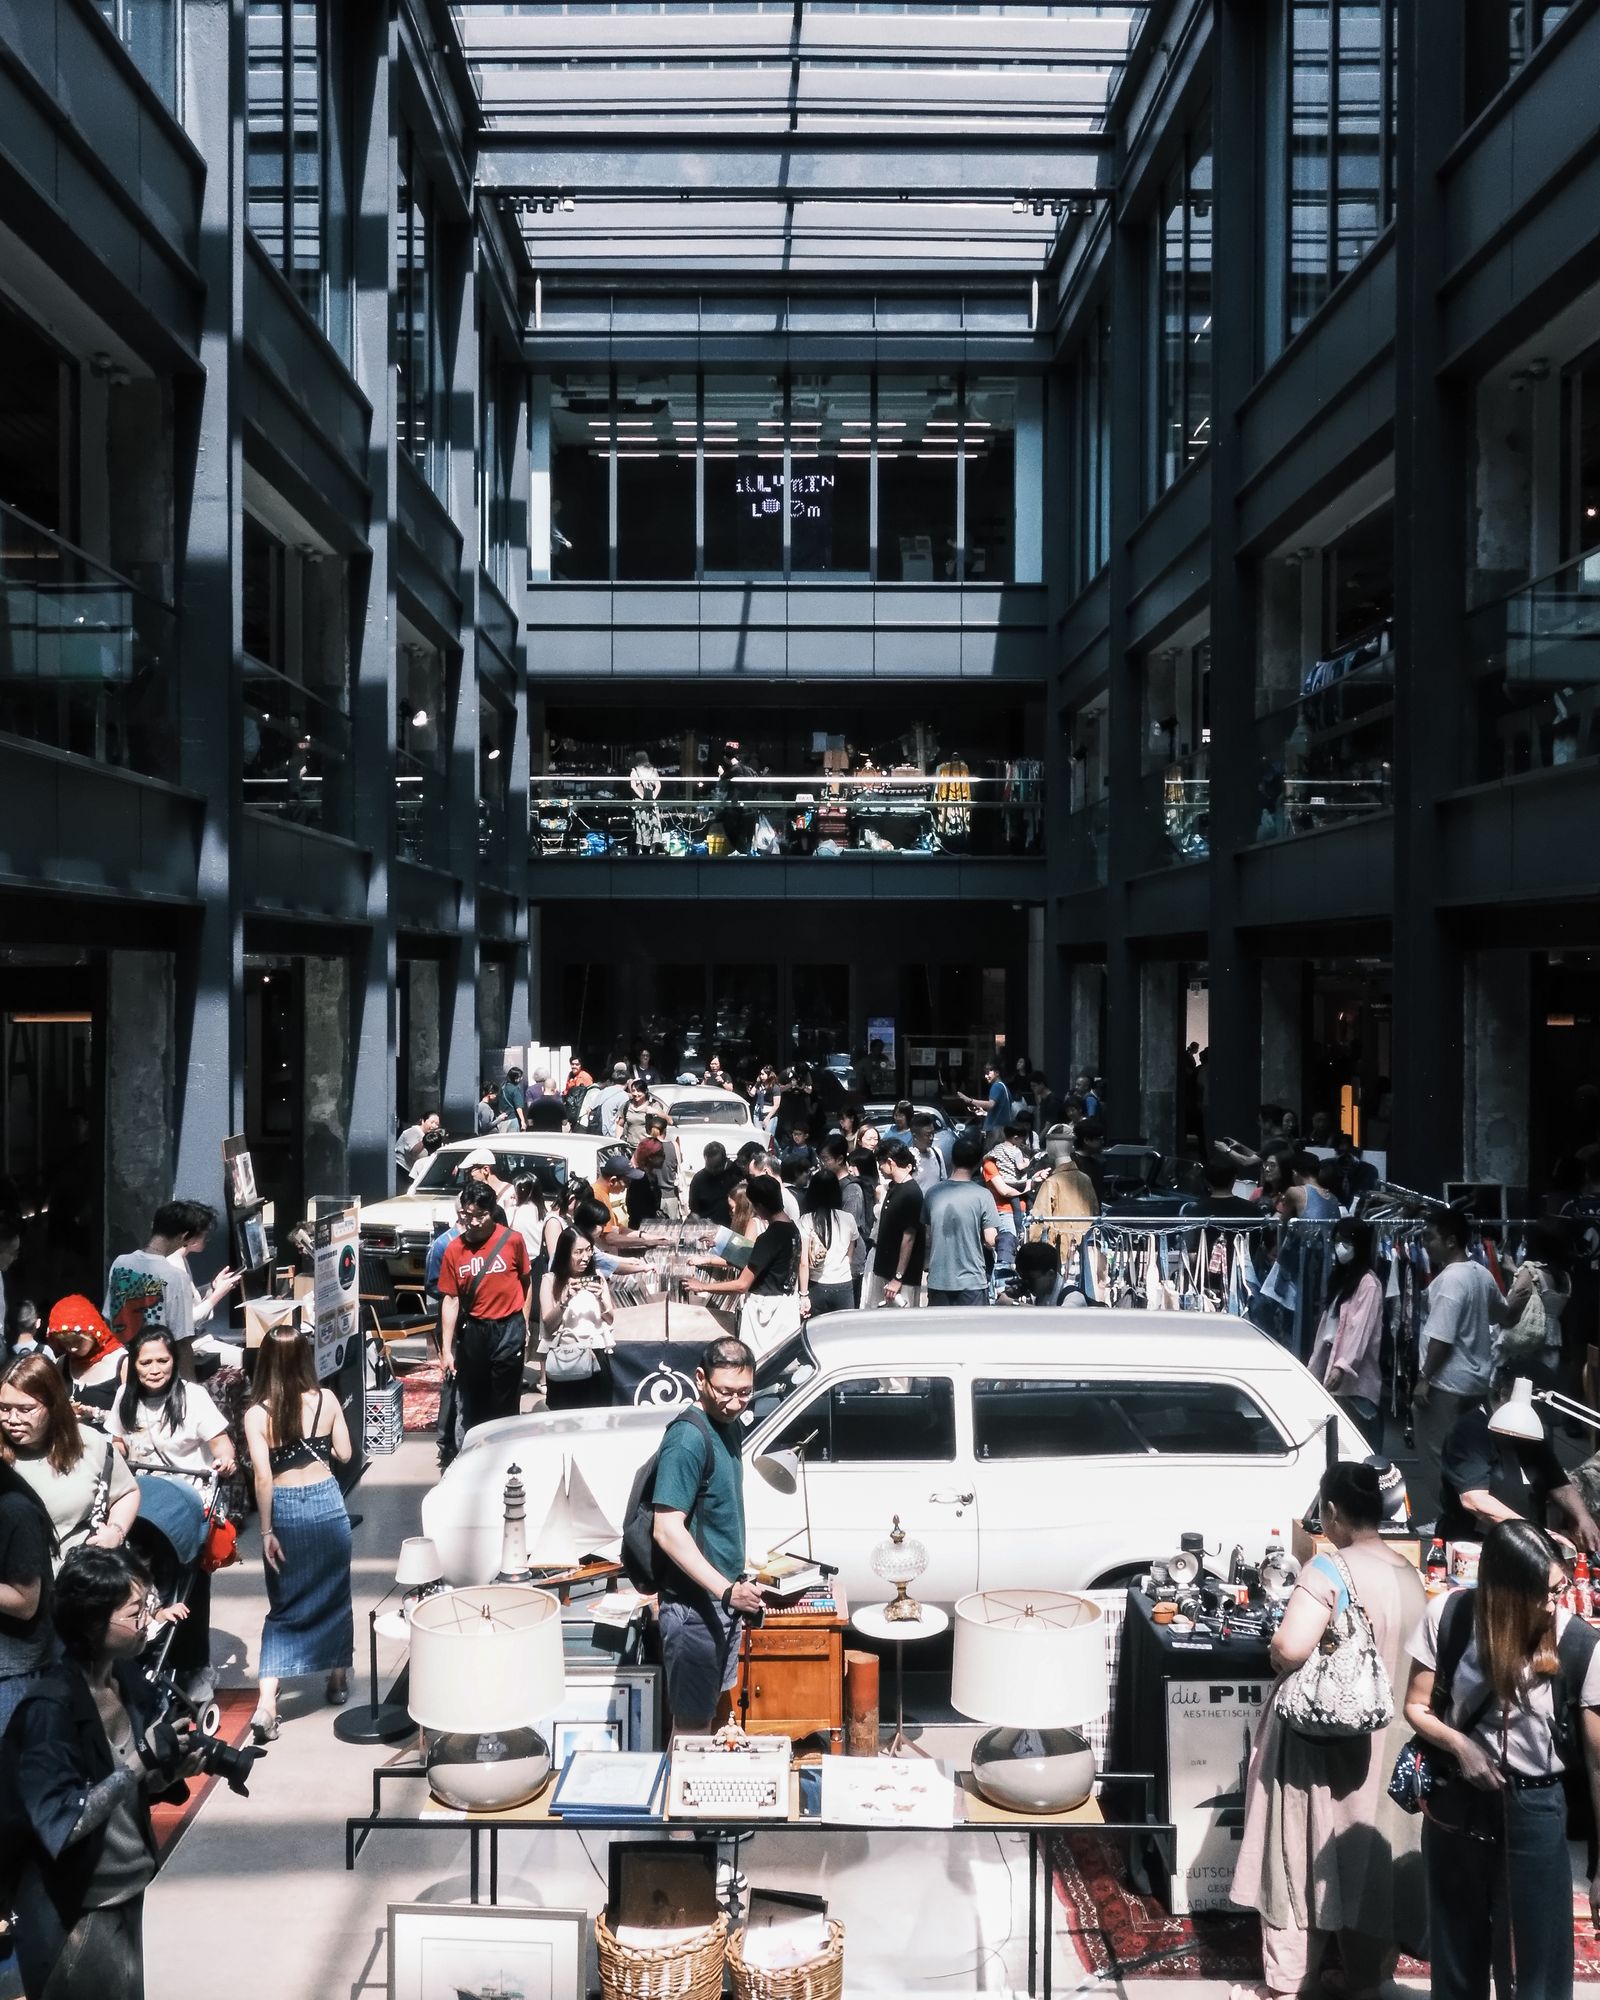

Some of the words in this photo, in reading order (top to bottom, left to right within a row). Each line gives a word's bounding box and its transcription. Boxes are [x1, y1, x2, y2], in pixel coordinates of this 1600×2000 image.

[1170, 1685, 1200, 1704] die
[1183, 1709, 1249, 1718] AESTHETISCH
[1177, 1866, 1235, 1879] DEUTSCH
[1207, 1884, 1231, 1893] GESE
